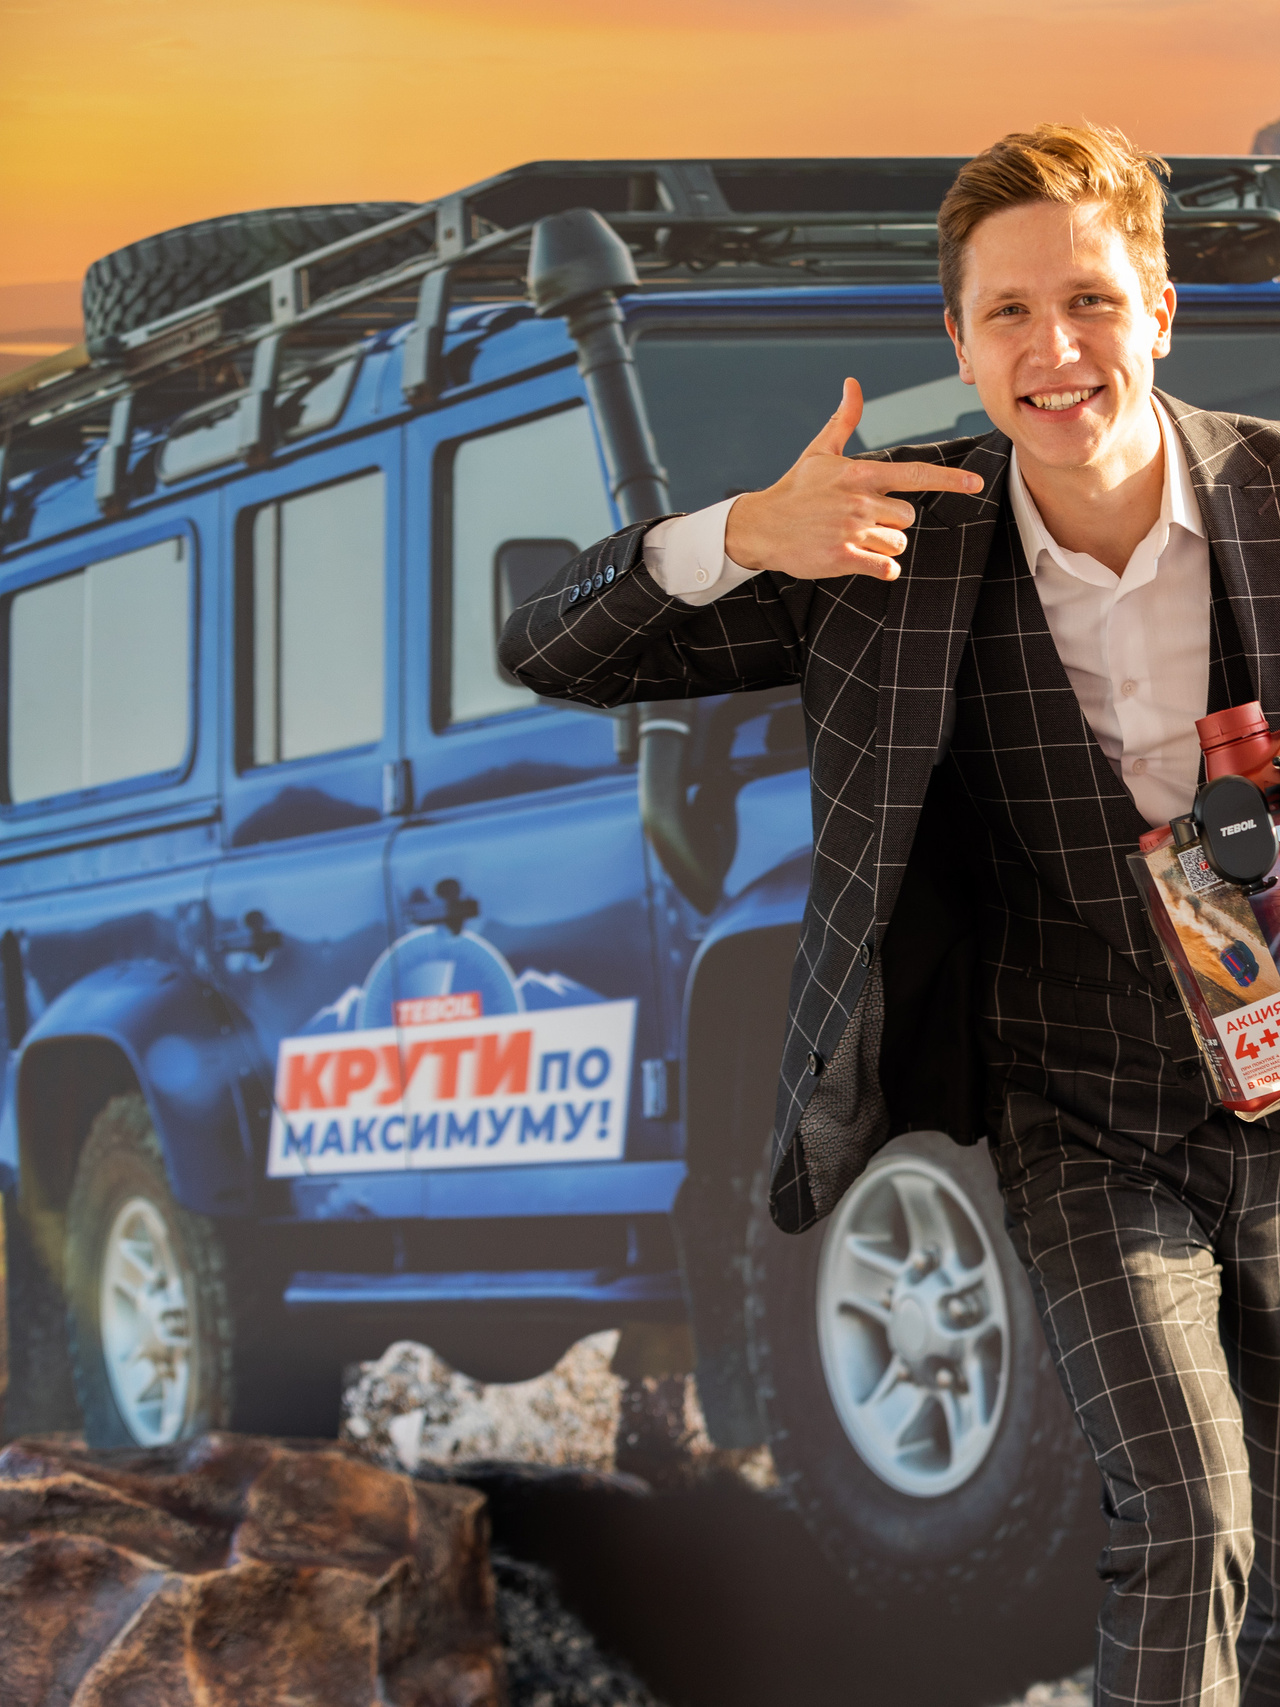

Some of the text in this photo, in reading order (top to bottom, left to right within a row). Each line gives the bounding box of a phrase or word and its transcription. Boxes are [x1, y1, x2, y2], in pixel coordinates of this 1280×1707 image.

[1220, 819, 1257, 837] TEBOIL
[284, 1030, 611, 1111] КРУТИ ПО
[1247, 1081, 1256, 1090] В
[281, 1100, 611, 1158] МАКСИМУМУ!
